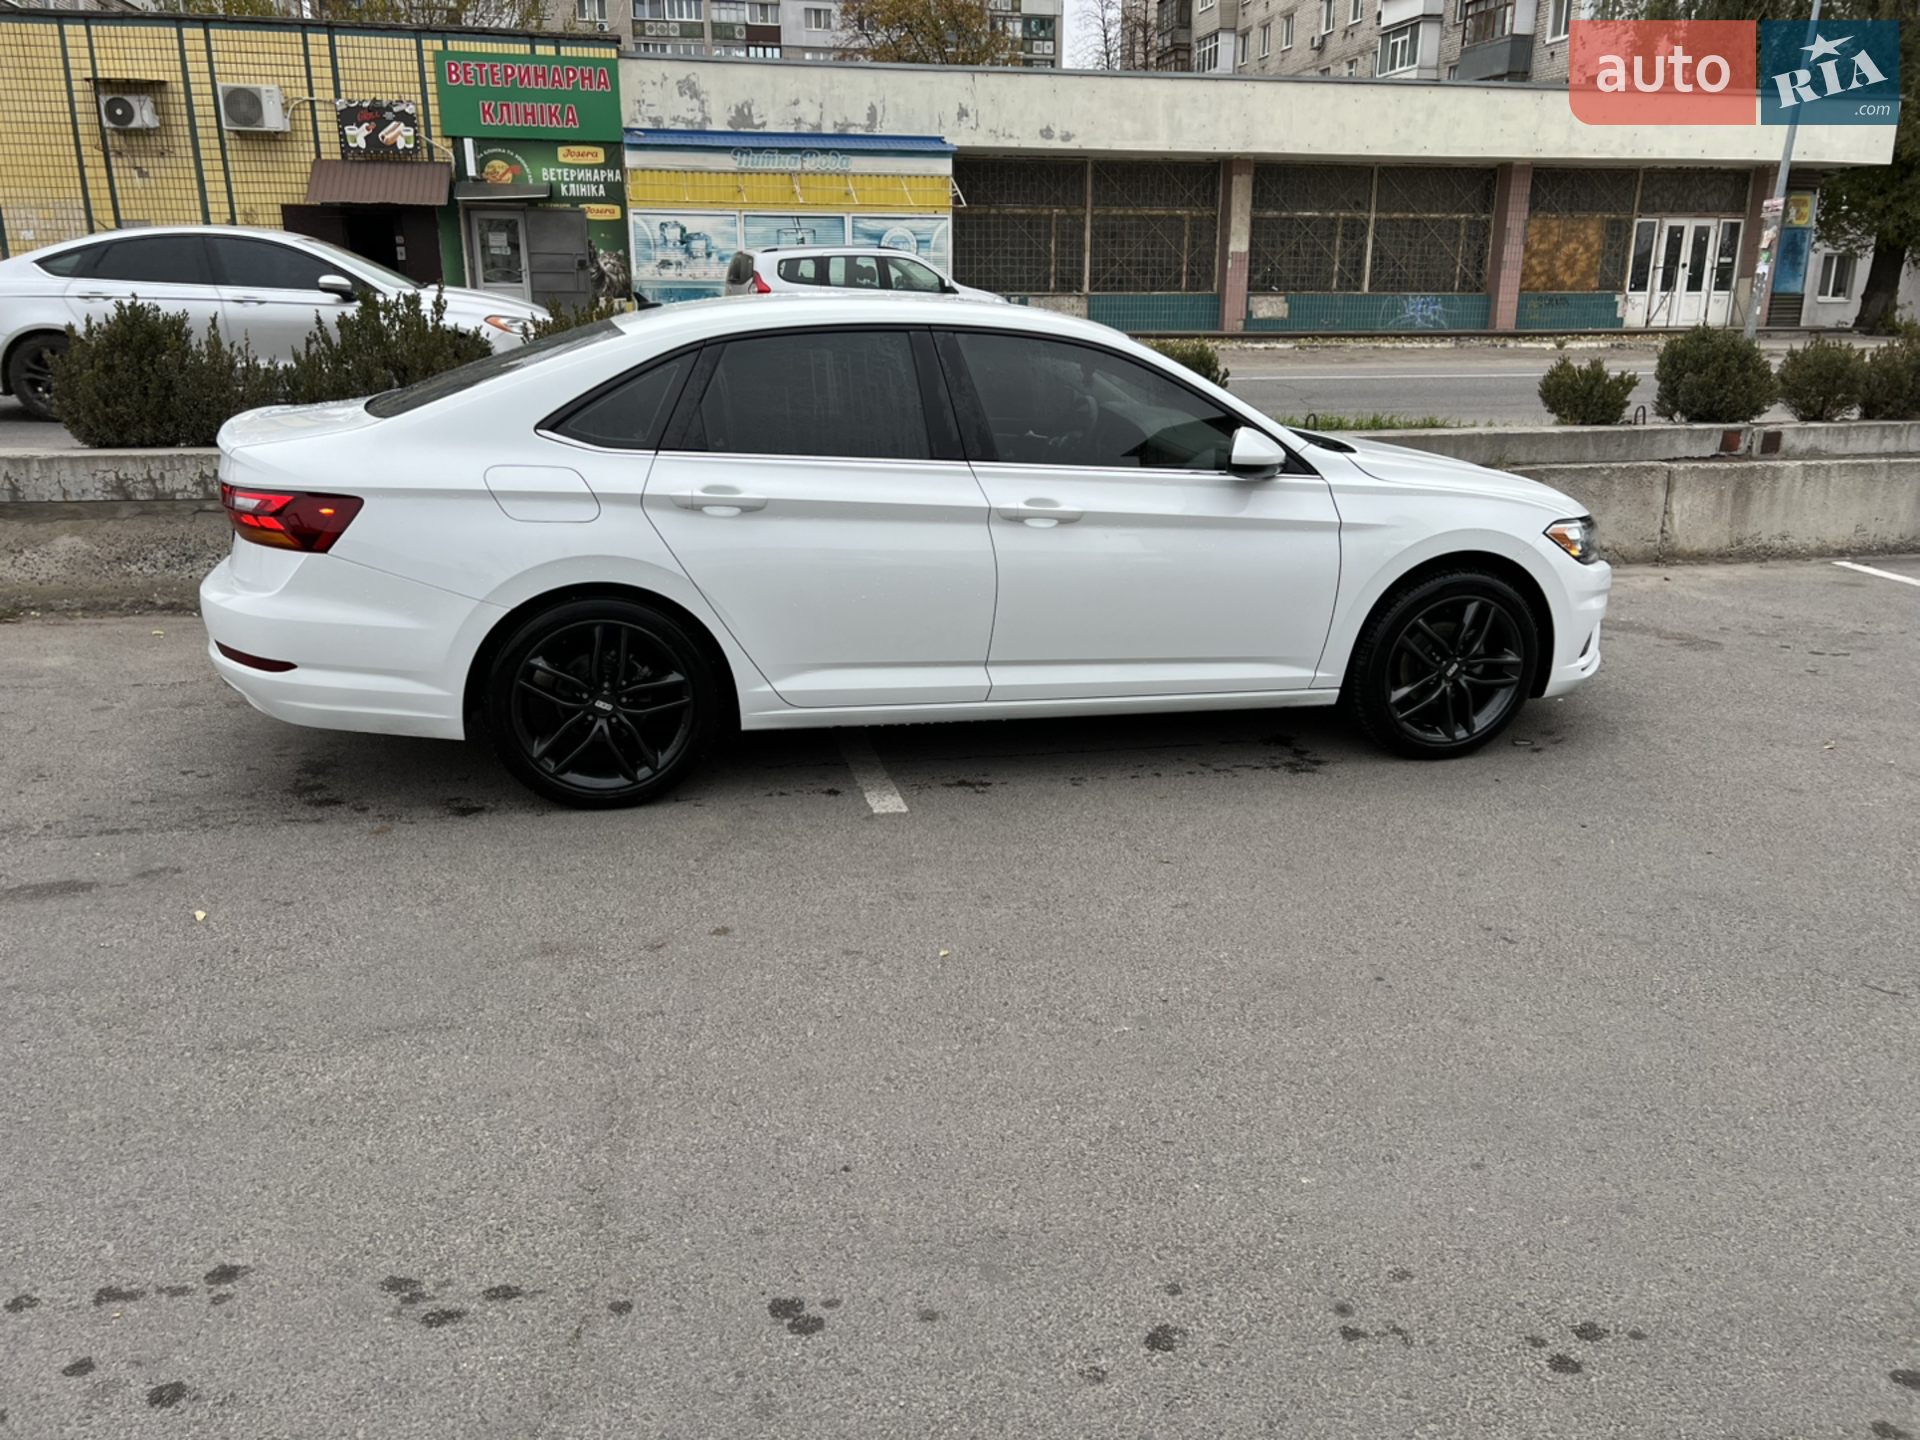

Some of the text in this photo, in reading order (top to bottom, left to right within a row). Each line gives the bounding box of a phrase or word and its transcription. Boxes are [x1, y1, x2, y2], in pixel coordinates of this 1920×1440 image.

[445, 60, 611, 92] ВЕТЕРИНАРНА
[479, 101, 579, 128] КЛІНІКА
[562, 149, 598, 158] Josera
[541, 167, 622, 182] ВЕТЕРИНАРНА
[560, 183, 606, 197] КЛІНІКА
